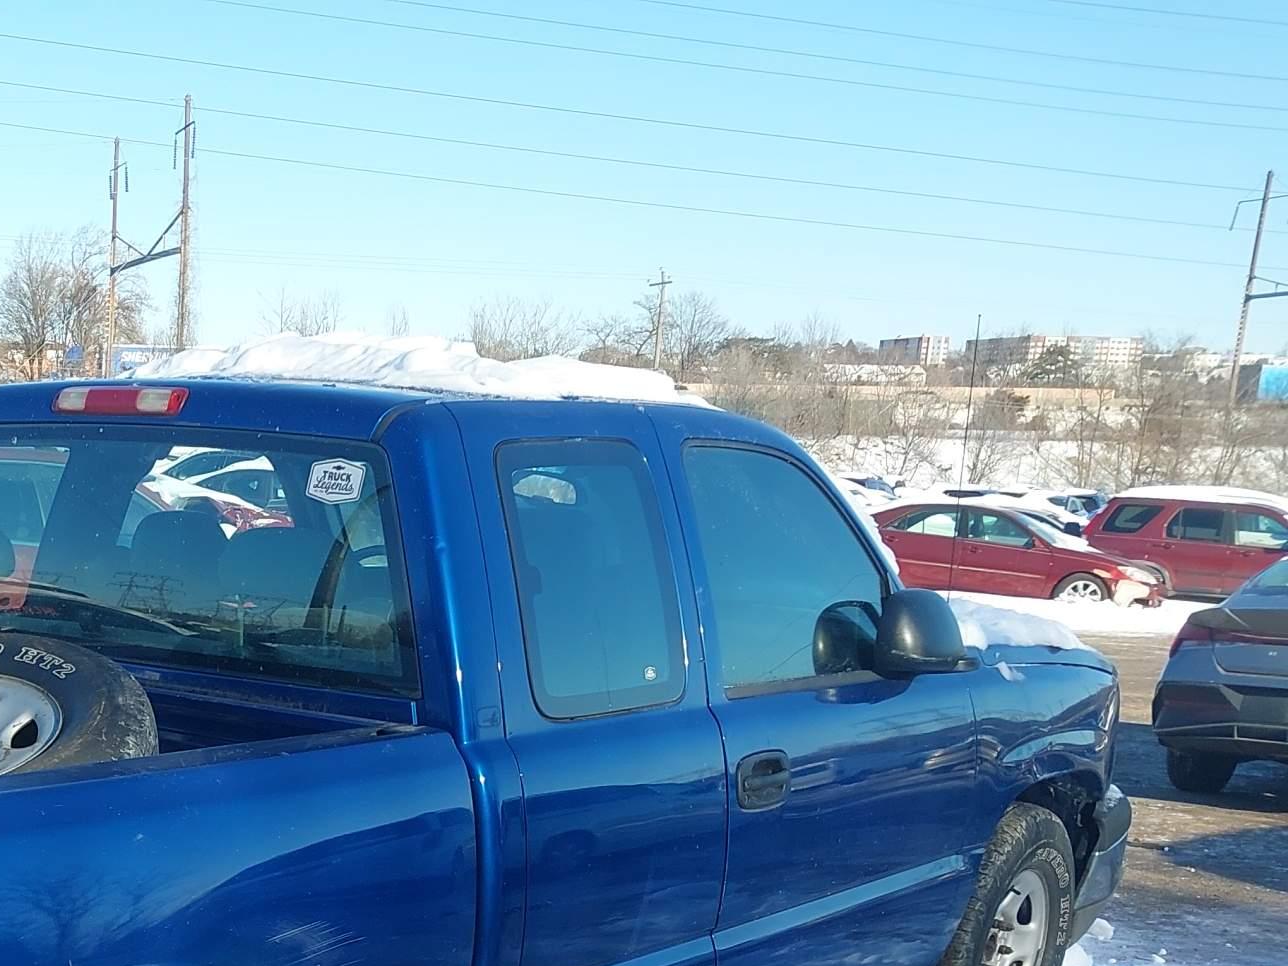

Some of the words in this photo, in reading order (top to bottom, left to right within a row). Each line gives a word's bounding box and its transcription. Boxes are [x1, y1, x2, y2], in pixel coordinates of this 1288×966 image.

[312, 476, 355, 495] Legends
[322, 470, 353, 483] TRUCK
[14, 646, 76, 679] HT2
